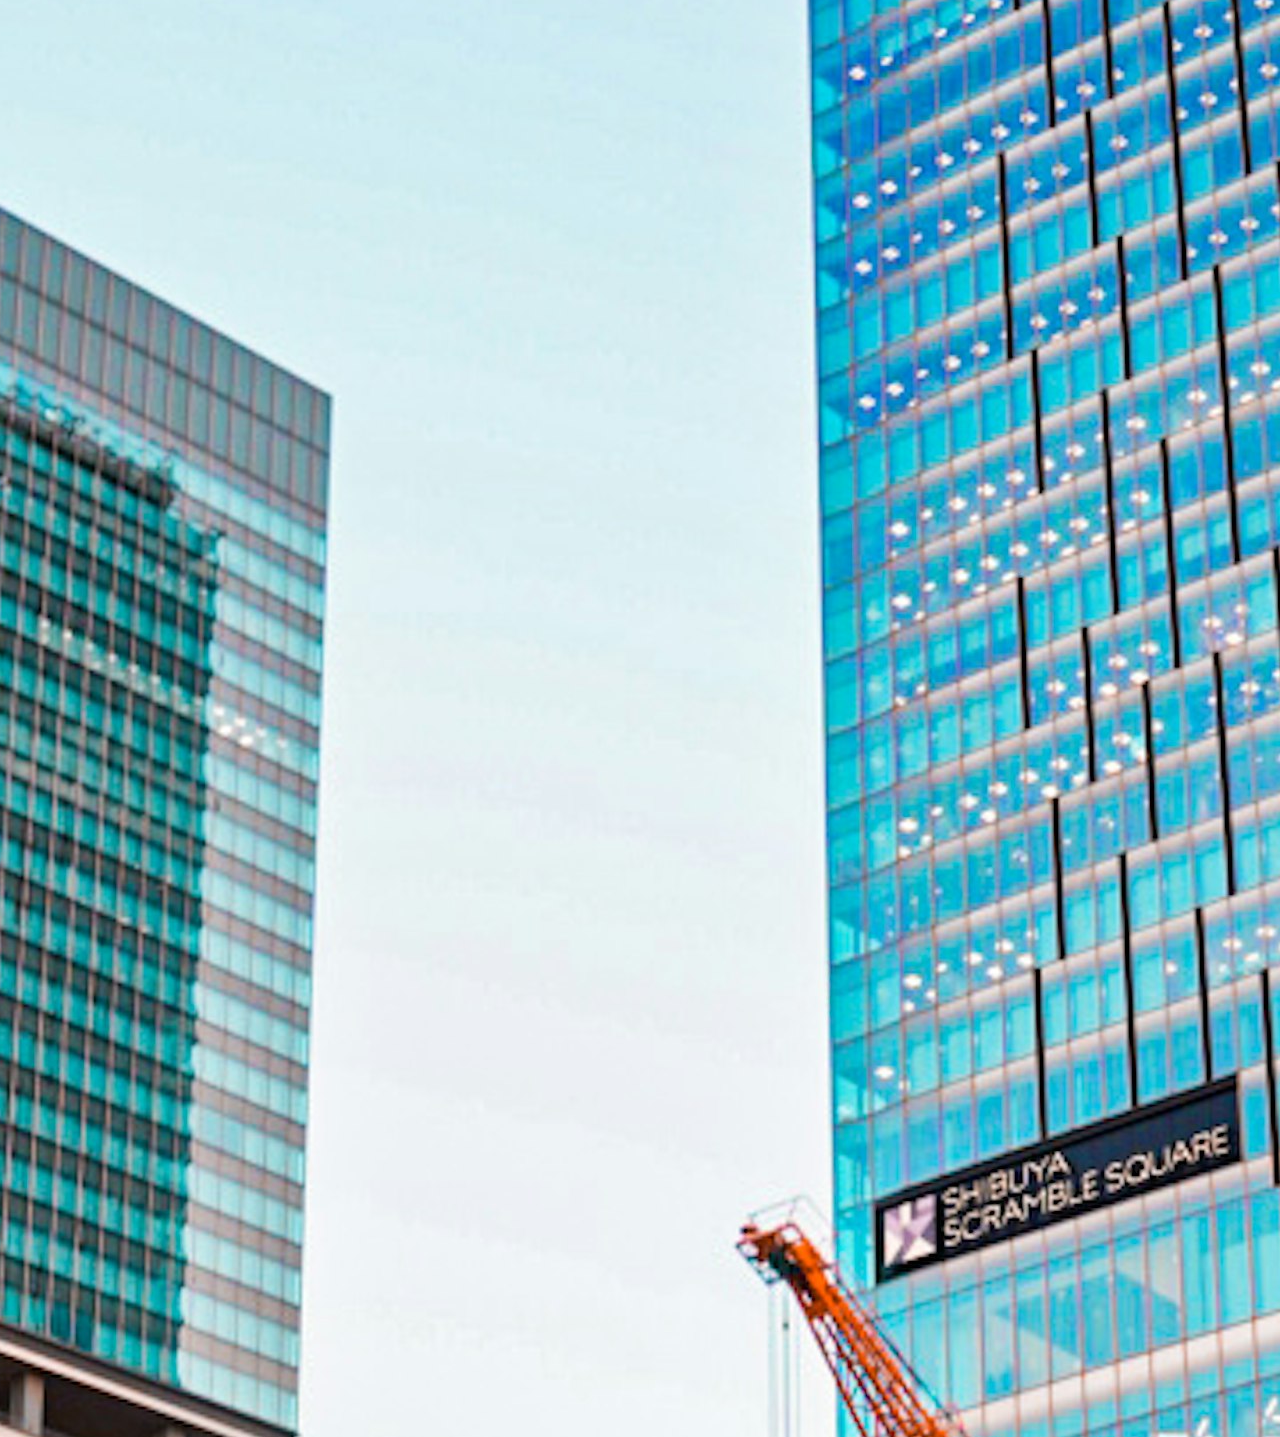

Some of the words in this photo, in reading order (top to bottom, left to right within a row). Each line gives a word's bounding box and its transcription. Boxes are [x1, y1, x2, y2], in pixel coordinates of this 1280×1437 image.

[942, 1150, 1069, 1217] SHIBUYA
[942, 1168, 1099, 1248] SCRAMBLE
[1103, 1124, 1229, 1194] SQUARE
